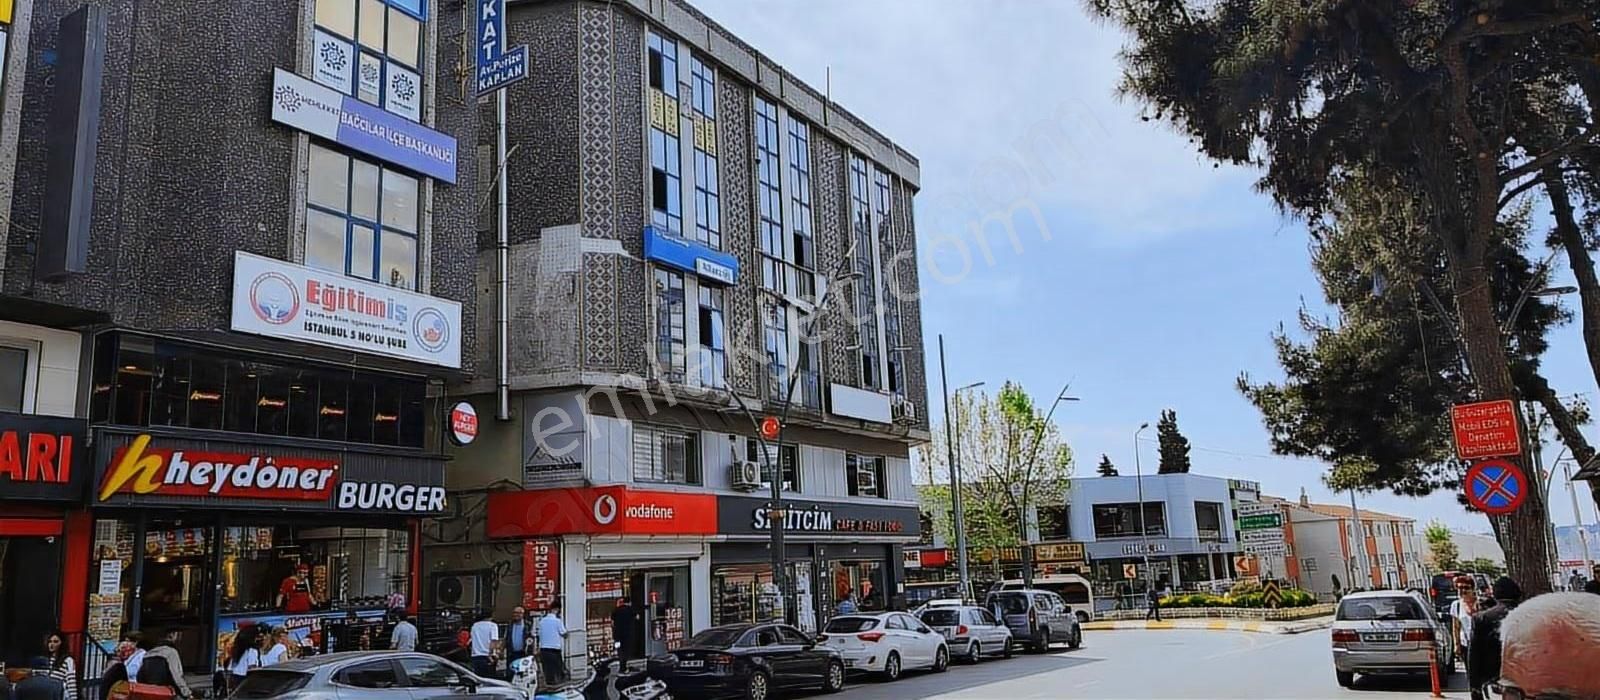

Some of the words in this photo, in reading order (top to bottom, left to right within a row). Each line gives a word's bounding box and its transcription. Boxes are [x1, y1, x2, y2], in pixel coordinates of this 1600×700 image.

[479, 64, 522, 91] KAPLAN
[1481, 419, 1499, 429] EDS
[0, 431, 72, 482] ARI
[163, 451, 334, 494] heydöner
[338, 482, 446, 512] BURGER
[625, 503, 673, 519] vodafone
[754, 502, 832, 531] SİİTCİM
